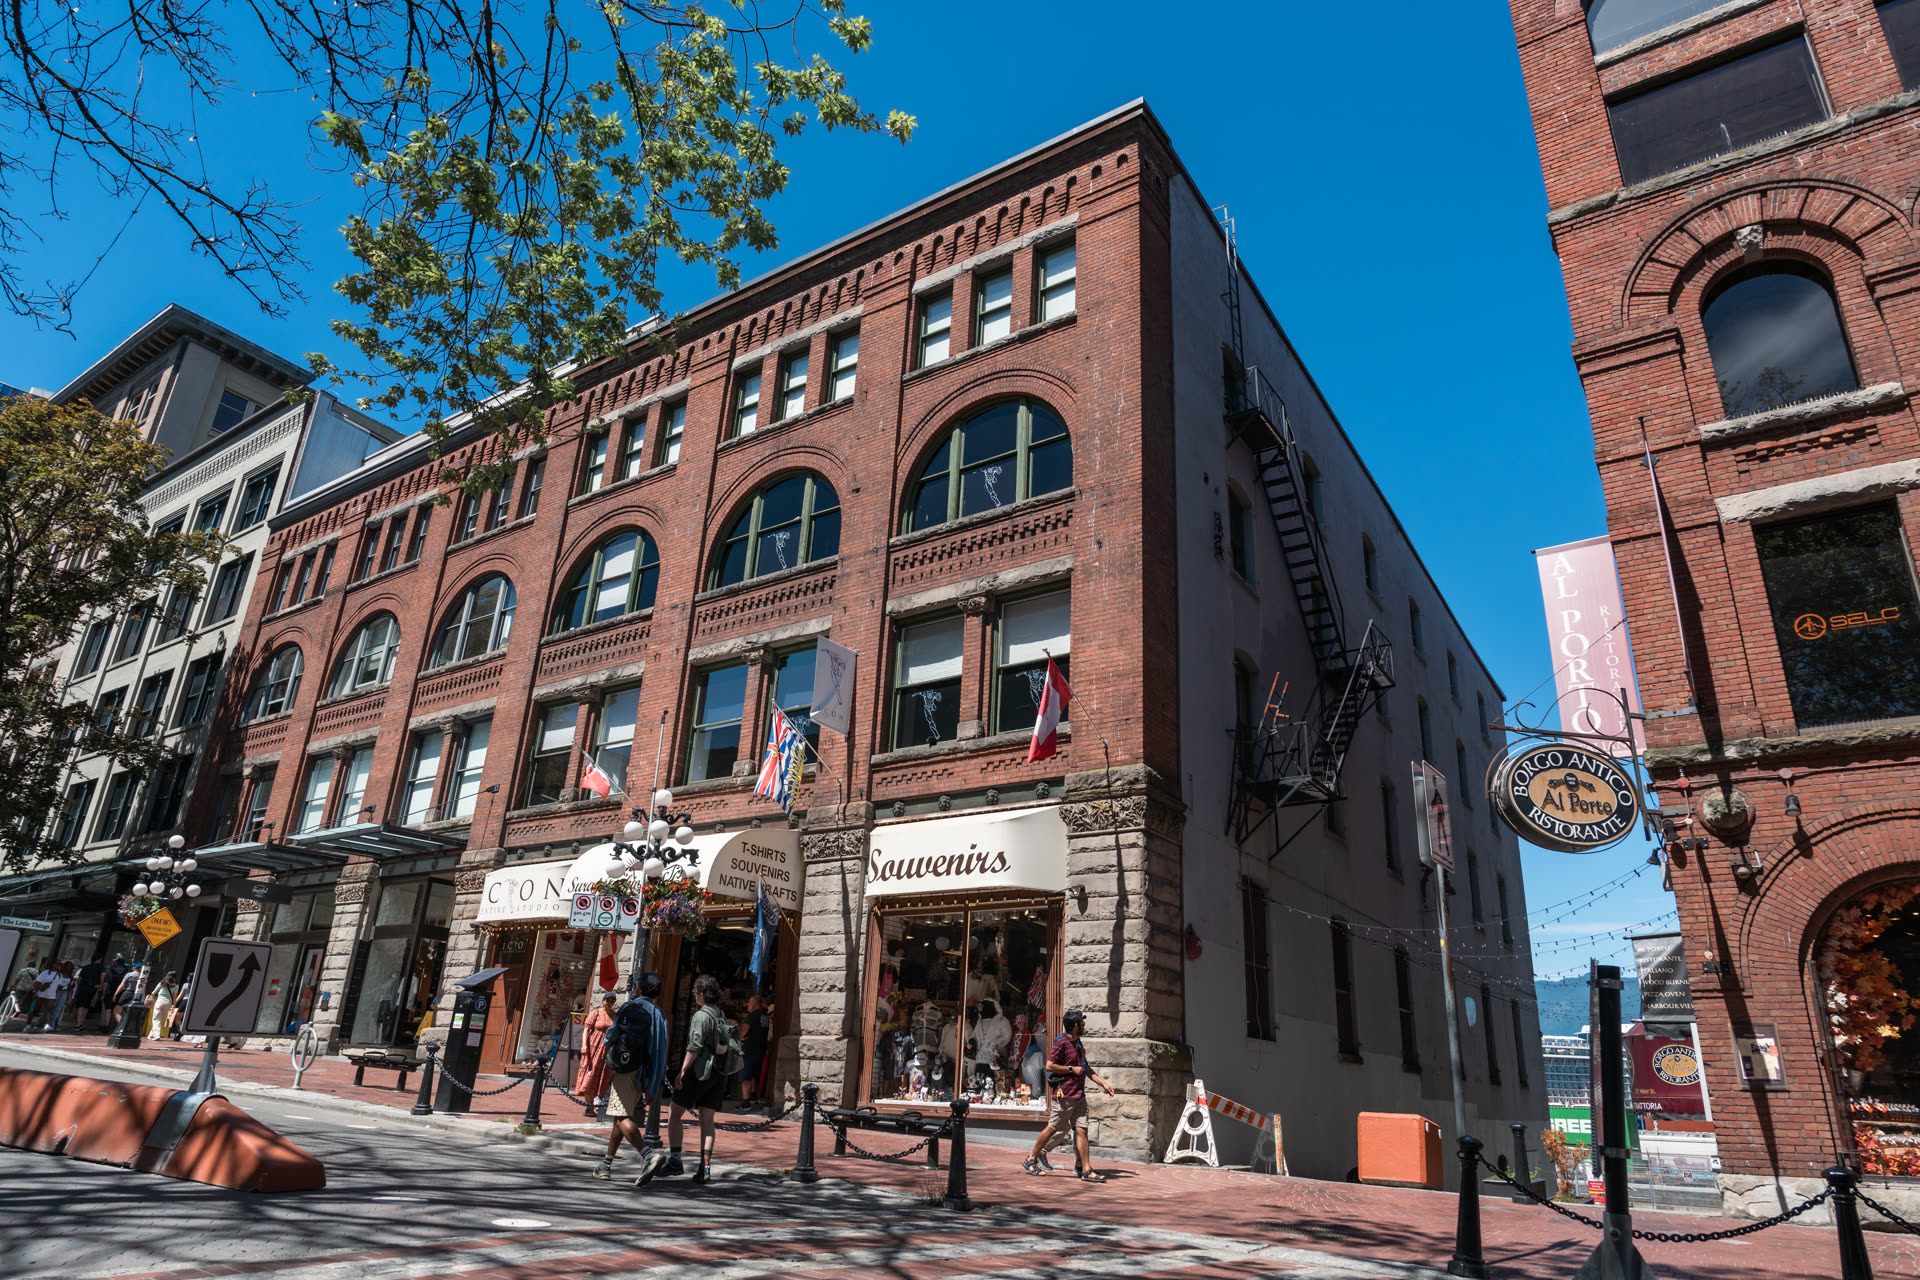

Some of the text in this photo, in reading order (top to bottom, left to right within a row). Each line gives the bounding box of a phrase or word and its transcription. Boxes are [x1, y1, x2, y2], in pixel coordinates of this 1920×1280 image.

[1829, 607, 1900, 627] SELC
[1552, 553, 1602, 735] AL PORTO
[1513, 751, 1633, 806] BORGO ANTICO
[1541, 789, 1613, 815] Al Porto
[1528, 806, 1626, 840] RISTORANTE
[741, 841, 786, 863] T-SHIRTS
[868, 843, 1011, 883] Souvenirs
[730, 857, 790, 882] SOUVENIRS
[719, 873, 797, 902] NATIVE RAFTS
[516, 903, 560, 913] STUDIO
[31, 922, 50, 930] Things
[1645, 1002, 1679, 1010] HARBOUR
[1654, 1047, 1674, 1068] BORGO
[1676, 1063, 1696, 1072] Porto
[1659, 1070, 1700, 1084] RISTORANT
